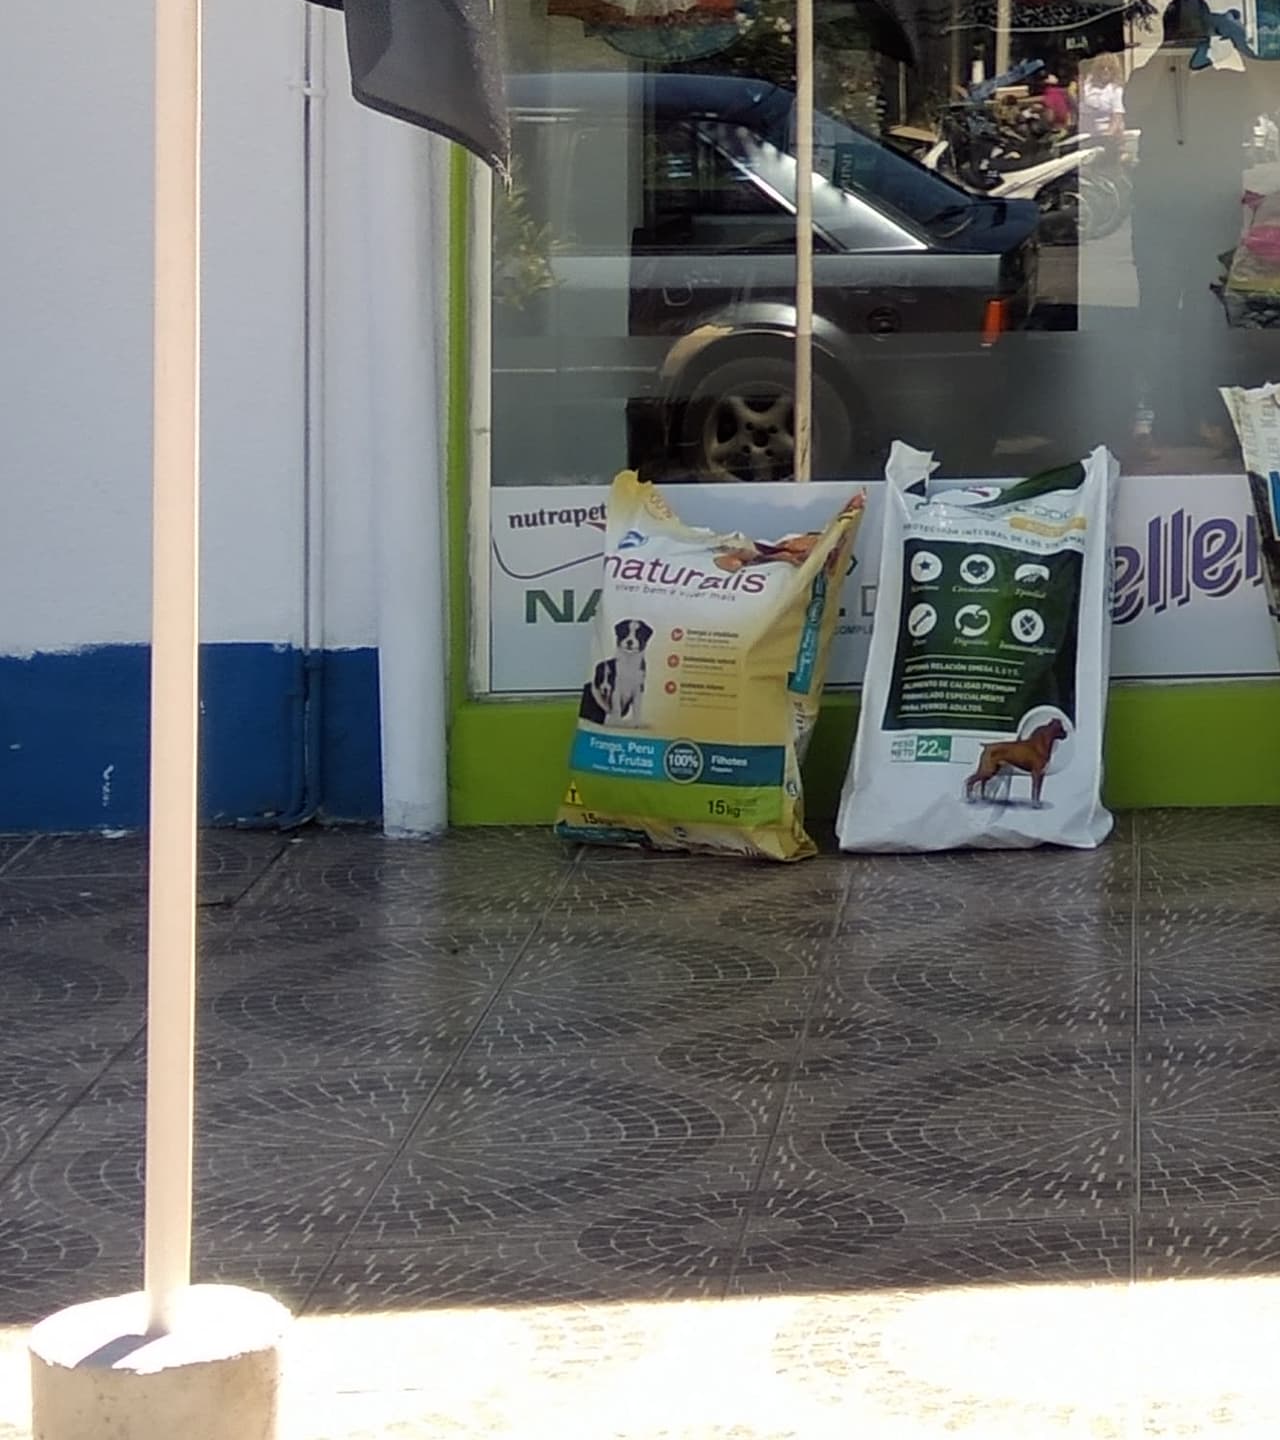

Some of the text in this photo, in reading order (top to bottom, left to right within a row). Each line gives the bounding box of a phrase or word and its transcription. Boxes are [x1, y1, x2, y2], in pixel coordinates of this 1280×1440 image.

[509, 503, 608, 529] nutrapet
[628, 743, 655, 755] Peru
[917, 740, 949, 759] 22kg
[618, 754, 654, 768] Frutas
[668, 753, 699, 769] 100%
[708, 800, 741, 818] 15kg
